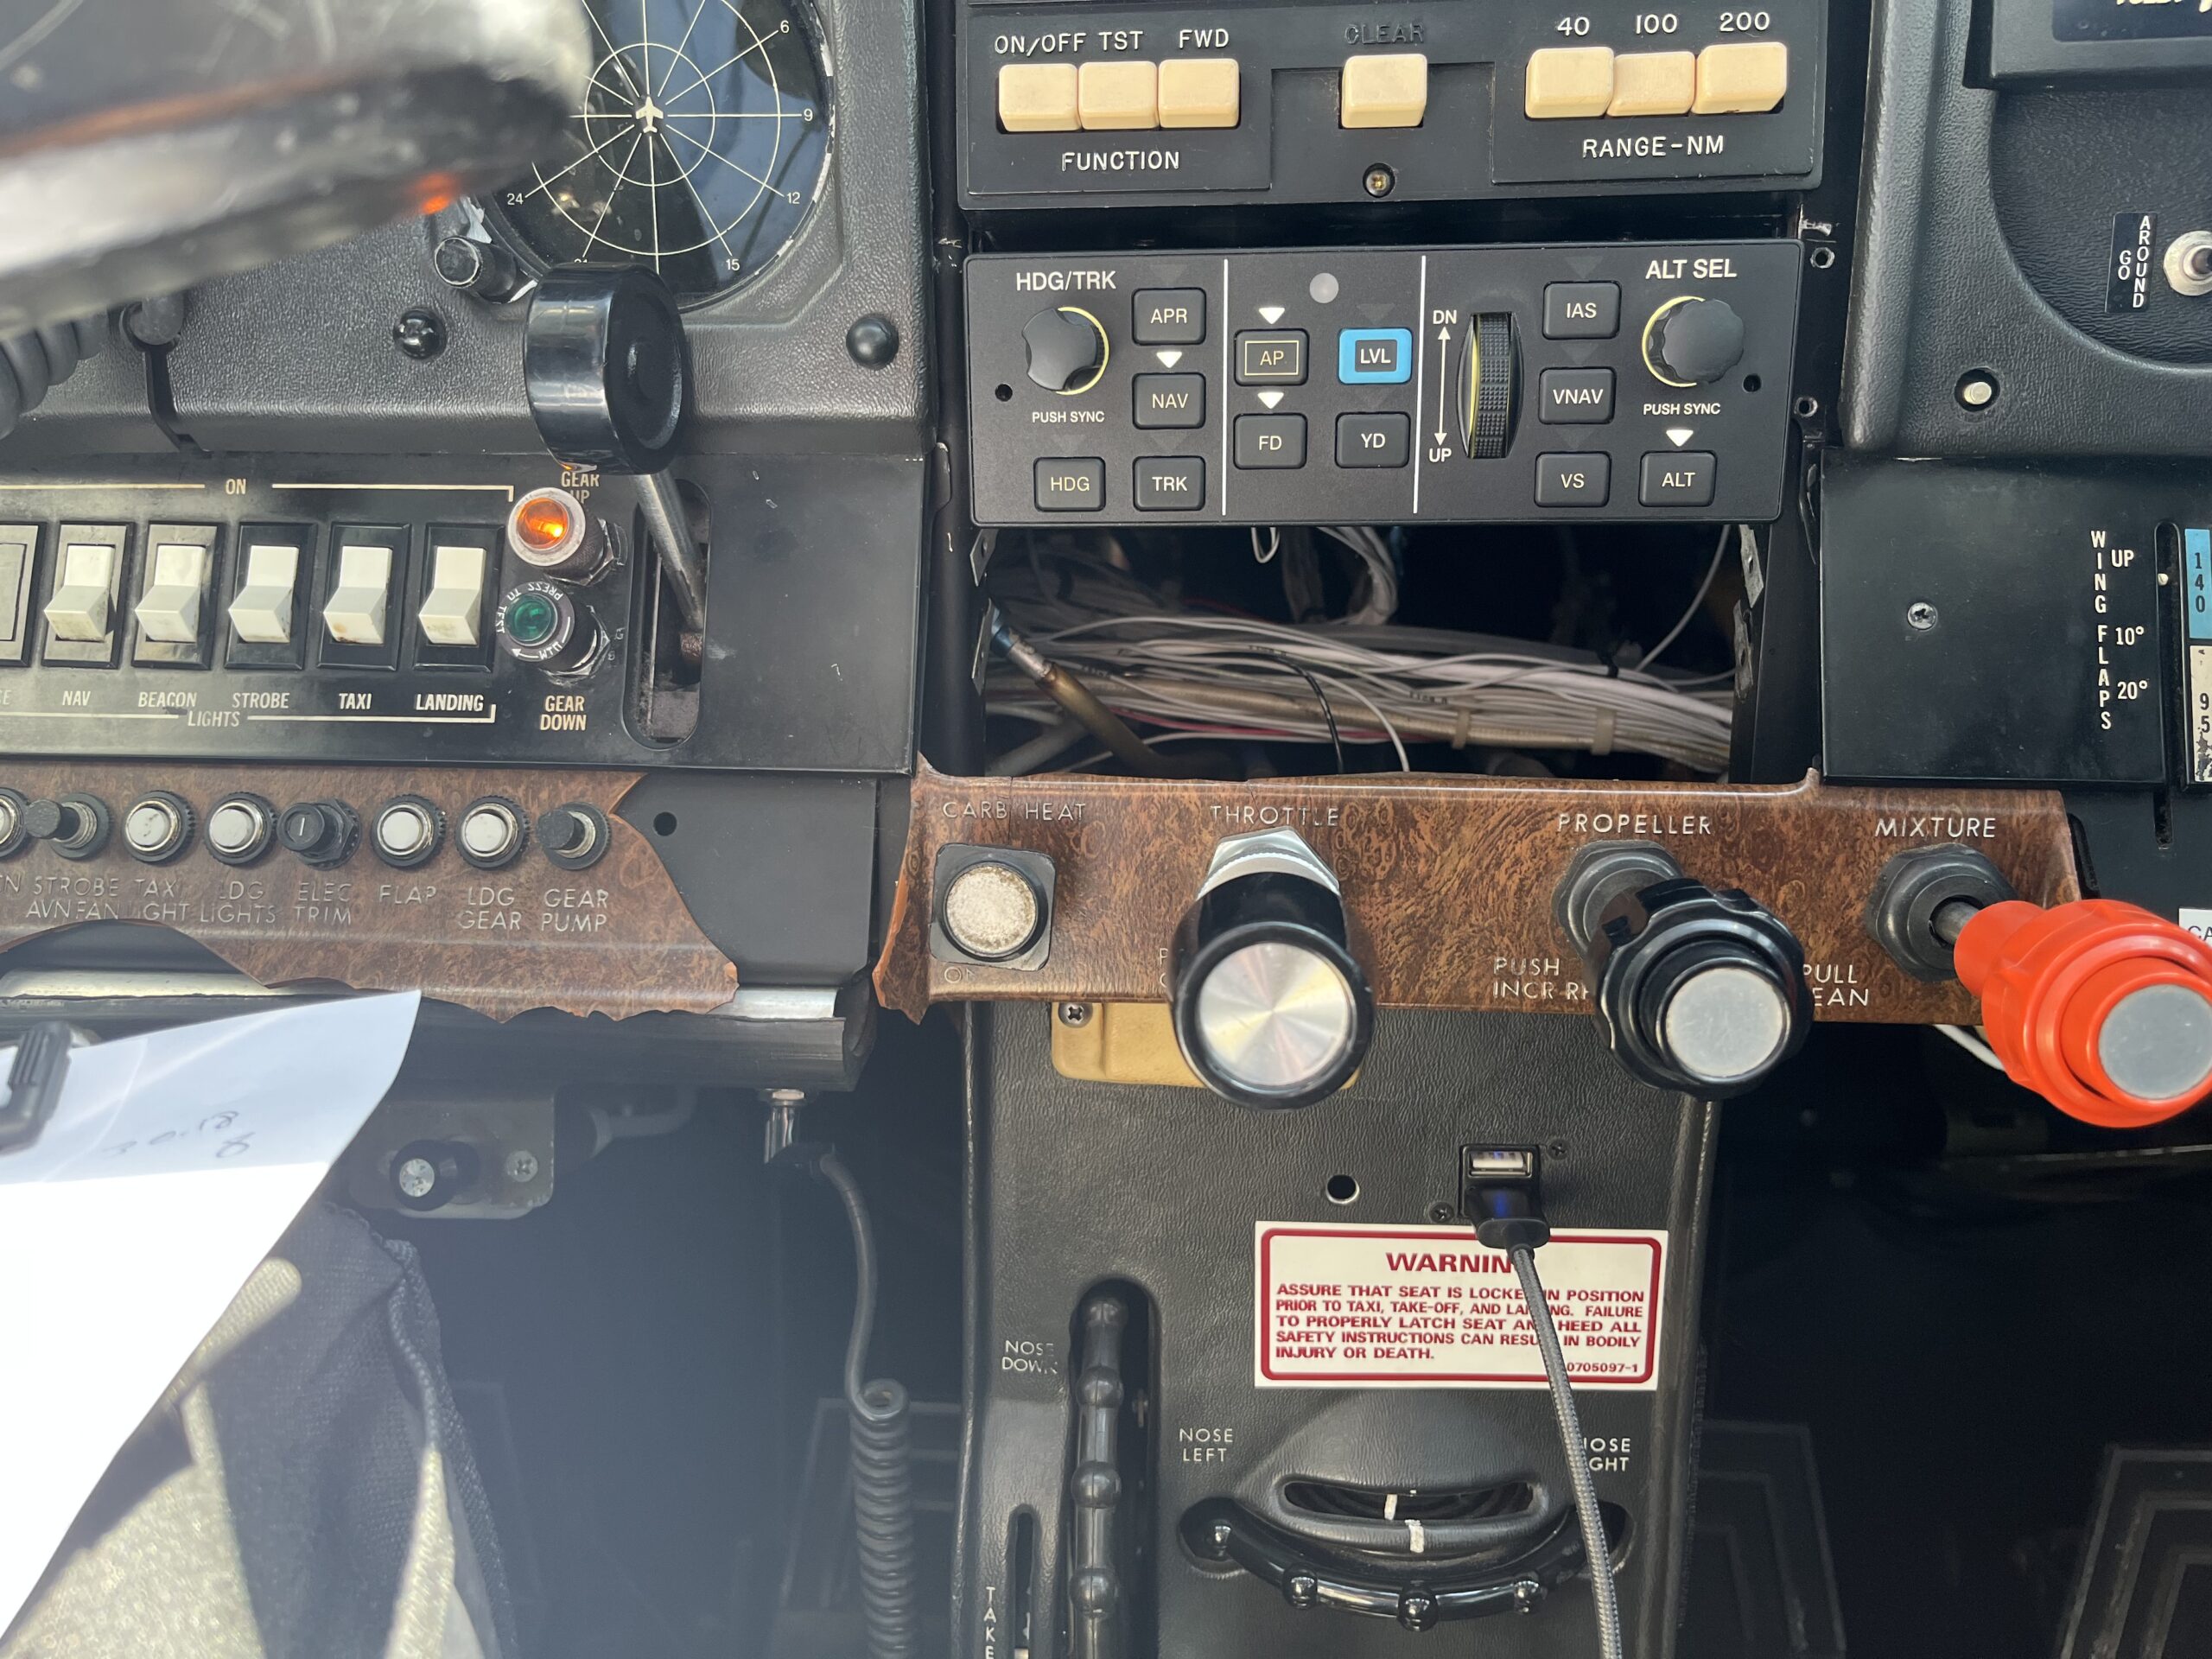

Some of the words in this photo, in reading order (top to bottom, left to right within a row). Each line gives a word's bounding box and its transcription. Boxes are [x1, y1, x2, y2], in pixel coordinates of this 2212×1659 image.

[780, 21, 790, 33] 6
[1557, 16, 1590, 36] 40
[1636, 14, 1678, 35] 100
[1719, 12, 1770, 31] 200
[1098, 30, 1143, 50] TST
[1179, 29, 1230, 48] FWD
[1344, 24, 1424, 45] CLEAR
[994, 32, 1086, 56] ON/OFF
[804, 110, 813, 121] 9
[1062, 151, 1180, 170] FUNCTION
[507, 194, 524, 204] 24
[786, 193, 800, 204] 12
[726, 259, 740, 271] 15
[1645, 260, 1687, 279] ALT
[1693, 258, 1737, 278] SEL
[2118, 251, 2132, 280] GO
[2133, 216, 2151, 308] AROUND
[1016, 271, 1116, 290] HDG/TRK
[1151, 308, 1187, 323] APR
[1433, 309, 1457, 324] DN
[1567, 302, 1597, 318] IAS
[1260, 351, 1284, 365] AP
[1360, 348, 1390, 364] LVL
[1152, 394, 1188, 409] NAV
[1553, 389, 1603, 404] VNAV
[1033, 411, 1066, 423] PUSH
[1071, 411, 1104, 423] SYNC
[1643, 404, 1680, 415] PUSH
[1684, 403, 1720, 415] SYNC
[1259, 435, 1282, 450] FD
[1361, 434, 1385, 448] YD
[1429, 448, 1452, 462] UP
[226, 479, 246, 494] ON
[1051, 477, 1090, 492] HDG
[1152, 477, 1187, 491] TRK
[1560, 474, 1585, 488] VS
[1662, 473, 1695, 487] ALT
[2112, 550, 2134, 567] UP
[2091, 531, 2107, 613] WING
[2098, 625, 2112, 729] FLAPS
[62, 690, 91, 706] NAV
[138, 691, 197, 708] BEACON
[232, 693, 289, 709] STROBE
[339, 693, 372, 709] TAXI
[416, 694, 484, 712] LANDING
[544, 696, 585, 712] GEAR
[188, 711, 240, 727] LIGHTS
[539, 715, 587, 731] DOWN
[943, 801, 1007, 819] CARB
[1026, 802, 1086, 821] HEAT
[1210, 805, 1338, 826] THROTTLE
[1557, 813, 1711, 836] PROPELLER
[1874, 817, 1996, 838] MIXTURE
[33, 875, 119, 897] STROBE
[298, 882, 353, 902] ELEC
[379, 884, 436, 905] FLAP
[467, 887, 515, 906] LDG
[543, 888, 609, 909] GEAR
[26, 899, 71, 918] AVN
[200, 904, 276, 924] LIGHTS
[294, 906, 352, 925] TRIM
[457, 910, 522, 930] GEAR
[541, 912, 607, 932] PUMP
[1493, 957, 1560, 976] PUSH
[1493, 981, 1554, 999] INCR
[1812, 988, 1868, 1007] EAN
[1385, 1253, 1511, 1274] WARNIN
[1277, 1283, 1341, 1296] ASSURE
[1348, 1284, 1393, 1297] THAT
[1398, 1286, 1440, 1298] SEAT
[1447, 1286, 1462, 1299] IS
[1470, 1287, 1524, 1300] LOCKE
[1567, 1290, 1644, 1302] POSITION
[1276, 1299, 1317, 1312] PRIOR
[1322, 1300, 1341, 1312] TO
[1346, 1300, 1384, 1313] TAXI,
[1390, 1301, 1464, 1316] TAKE-OFF,
[1470, 1303, 1501, 1314] AND
[1586, 1306, 1643, 1318] FAILURE
[1276, 1315, 1300, 1327] TO
[1306, 1316, 1392, 1328] PROPERLY
[1399, 1317, 1455, 1329] LATCH
[1463, 1319, 1506, 1331] SEAT
[1558, 1320, 1603, 1332] HEED
[1610, 1320, 1642, 1332] ALL
[1276, 1331, 1335, 1343] SAFETY
[1342, 1332, 1454, 1344] INSTRUCTIONS
[1461, 1333, 1494, 1345] CAN
[1500, 1334, 1538, 1346] RESU
[1563, 1335, 1580, 1346] IN
[1586, 1336, 1641, 1348] BODILY
[1276, 1346, 1337, 1359] INJURY
[1344, 1347, 1366, 1359] OR
[1374, 1347, 1434, 1359] DEATH.
[1567, 1362, 1637, 1373] 0705097-1
[1179, 1427, 1233, 1443] NOSE
[1583, 1437, 1631, 1452] OSE
[1182, 1448, 1228, 1462] LEFT
[1589, 1456, 1630, 1471] GHT
